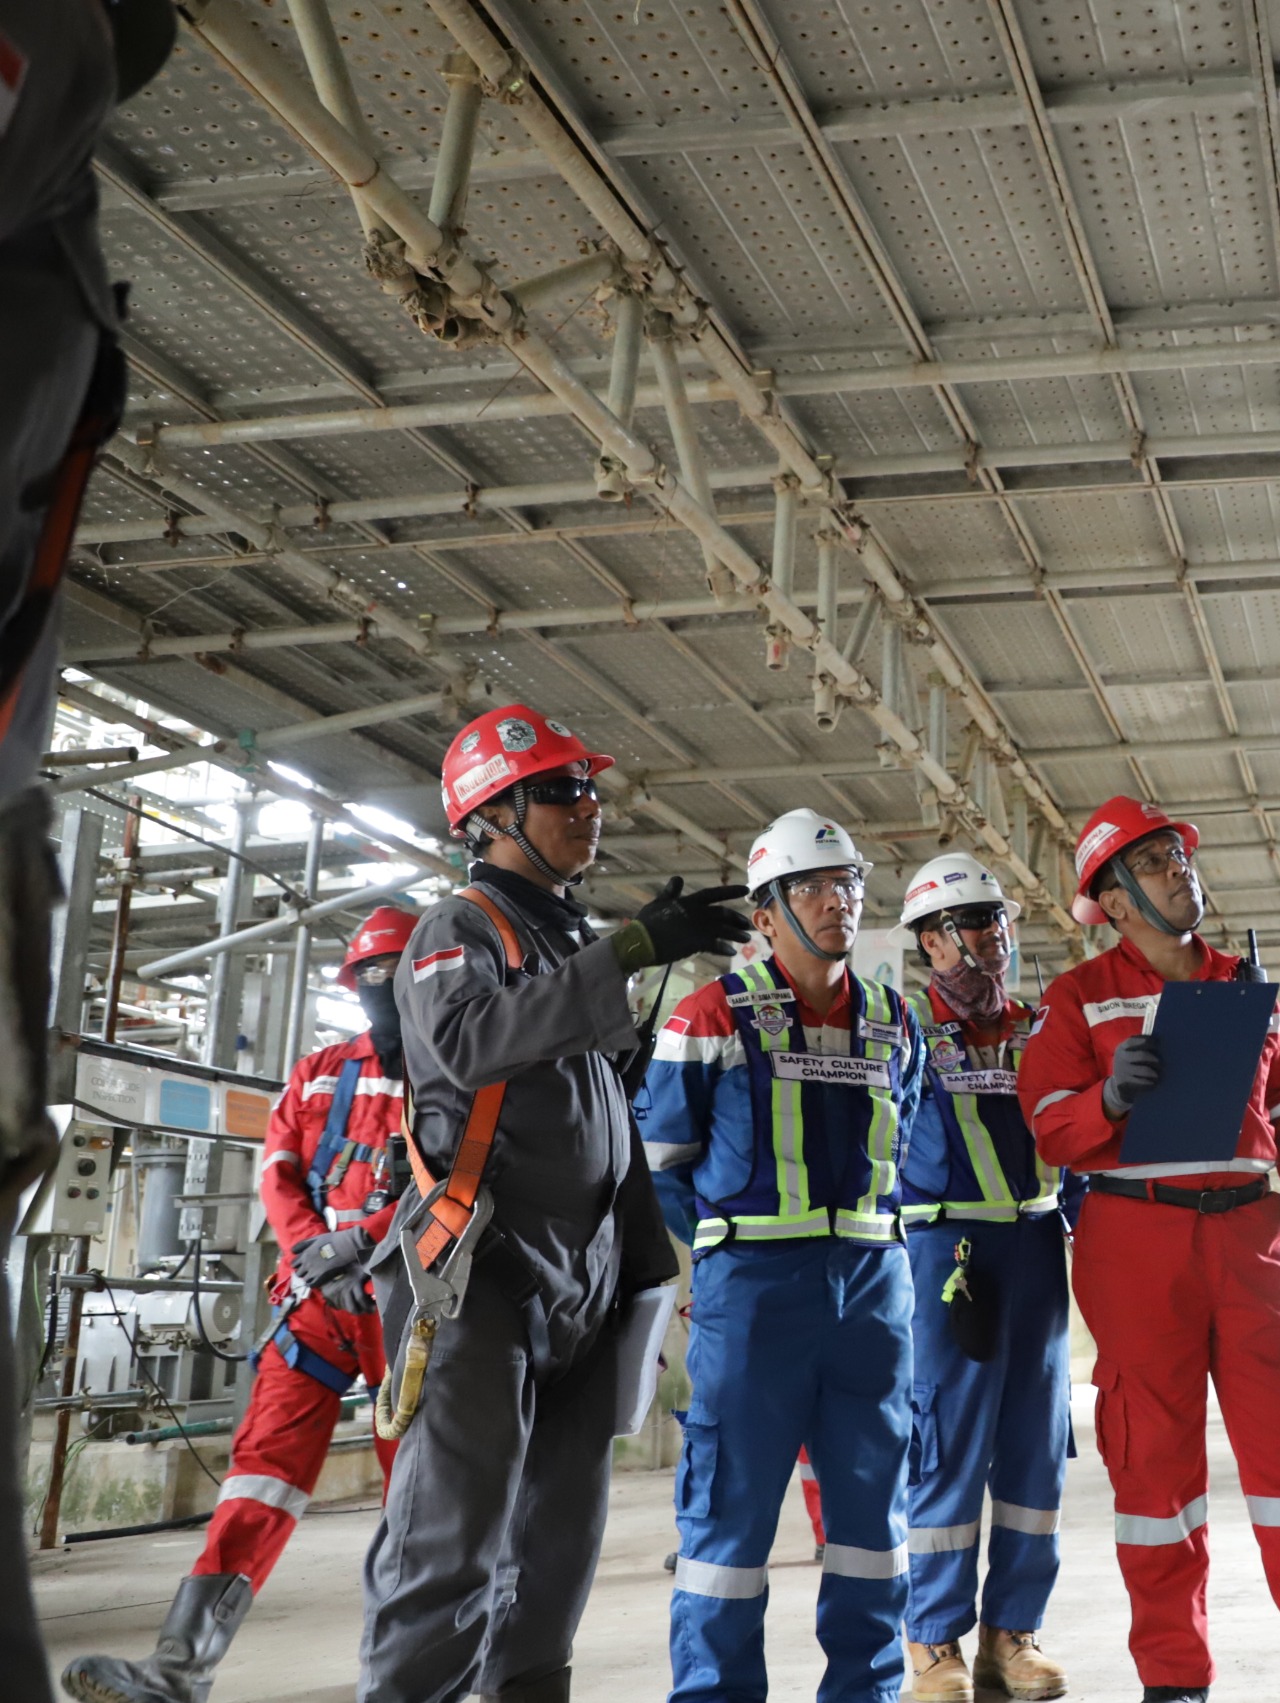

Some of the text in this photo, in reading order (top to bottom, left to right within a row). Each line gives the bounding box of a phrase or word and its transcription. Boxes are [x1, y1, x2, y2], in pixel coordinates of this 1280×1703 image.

[779, 1055, 883, 1073] SAFETY CULTURE
[802, 1068, 867, 1080] CHAMPION
[947, 1073, 987, 1082] SAFETY
